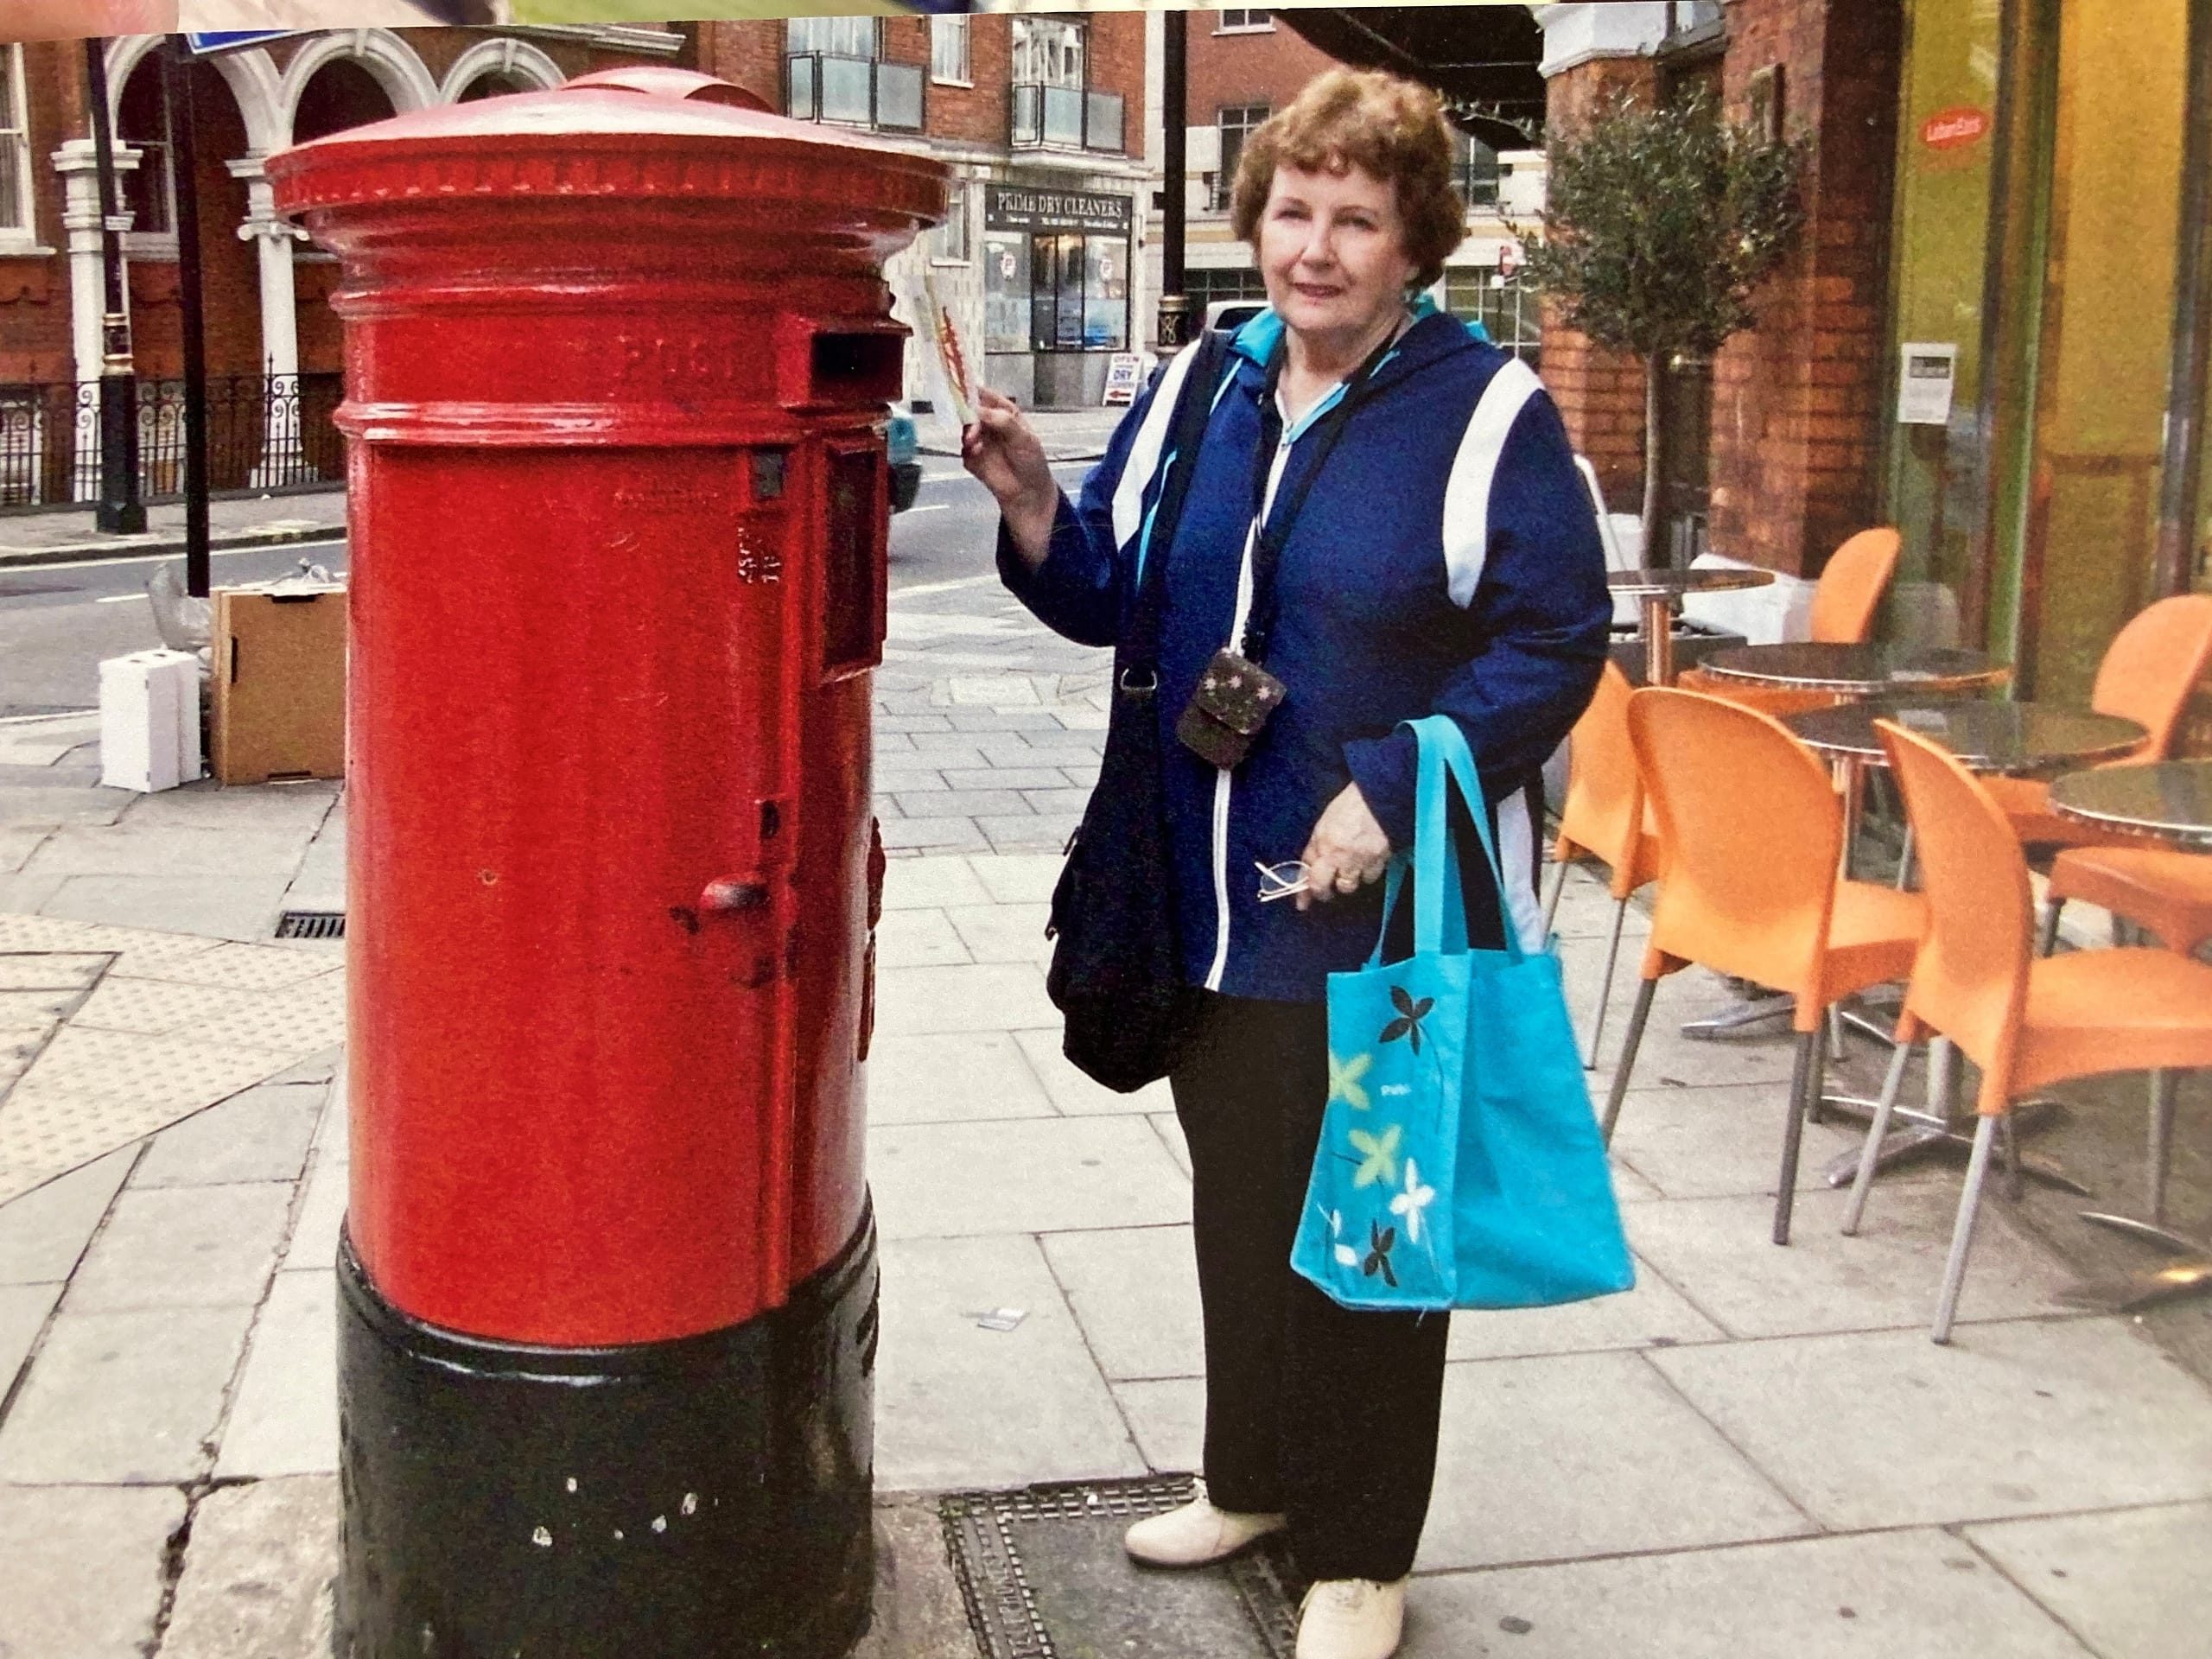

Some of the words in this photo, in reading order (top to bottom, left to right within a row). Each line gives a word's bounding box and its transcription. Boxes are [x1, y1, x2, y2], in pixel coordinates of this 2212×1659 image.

[998, 193, 1036, 212] PRIME
[1038, 195, 1063, 213] DRY
[1065, 197, 1122, 219] CLEANERS
[1114, 370, 1132, 380] DRY
